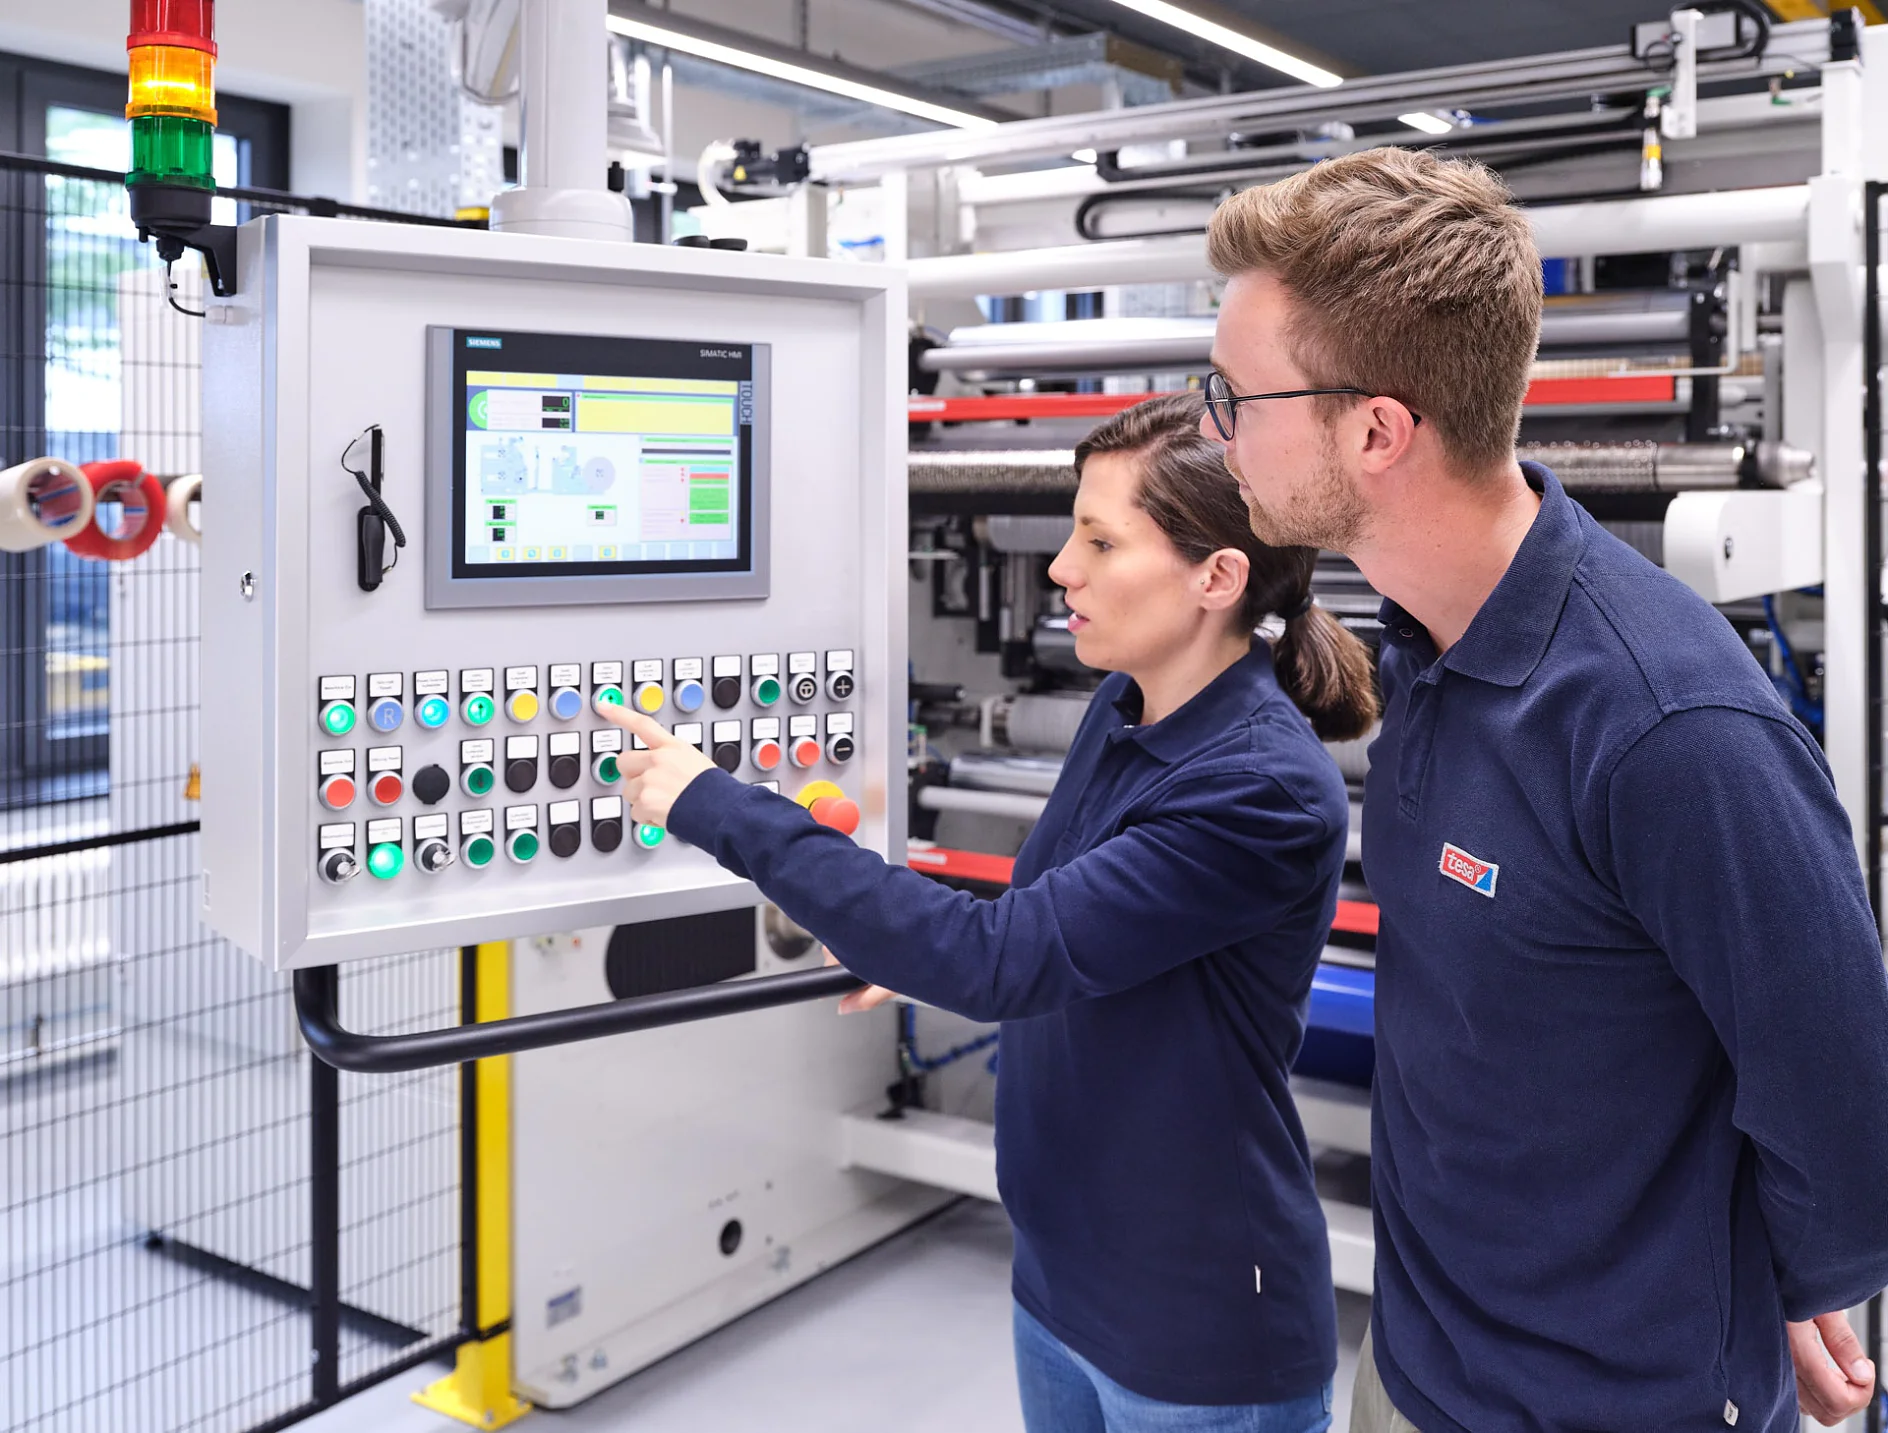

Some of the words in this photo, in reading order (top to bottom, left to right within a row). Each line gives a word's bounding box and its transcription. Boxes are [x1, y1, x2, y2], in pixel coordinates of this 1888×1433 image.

[468, 338, 501, 348] SIEMENS
[699, 349, 728, 359] SIMATIC
[728, 350, 743, 360] HMI
[741, 382, 753, 424] TOUCH
[383, 707, 395, 726] R
